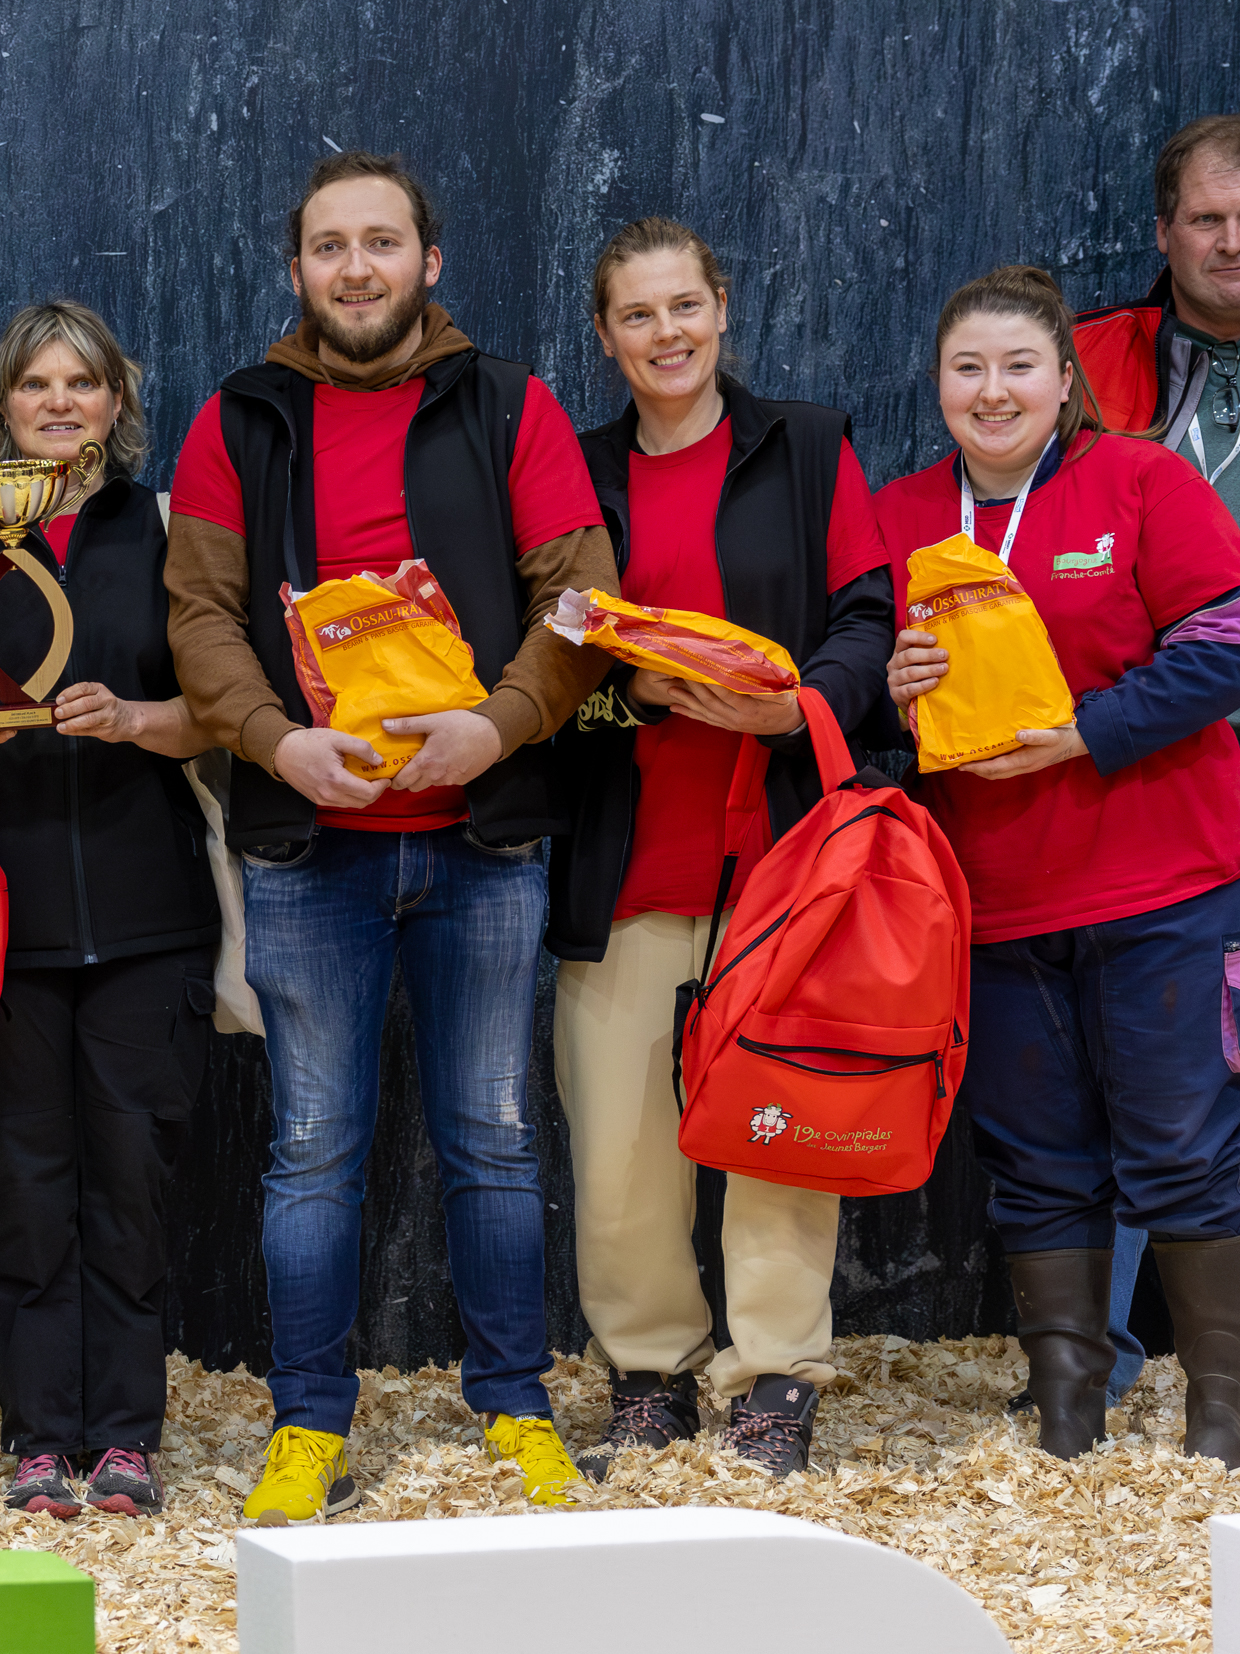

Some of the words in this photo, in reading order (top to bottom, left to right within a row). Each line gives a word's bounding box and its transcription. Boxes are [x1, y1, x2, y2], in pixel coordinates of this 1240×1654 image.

[932, 579, 1010, 613] OSSAU-IRATY
[961, 605, 988, 617] BASQUE
[370, 631, 386, 640] PAYS
[793, 1124, 821, 1143] 19e
[824, 1127, 893, 1145] Ovinpiades
[820, 1142, 853, 1152] Jeunes
[854, 1142, 887, 1154] Bergers
